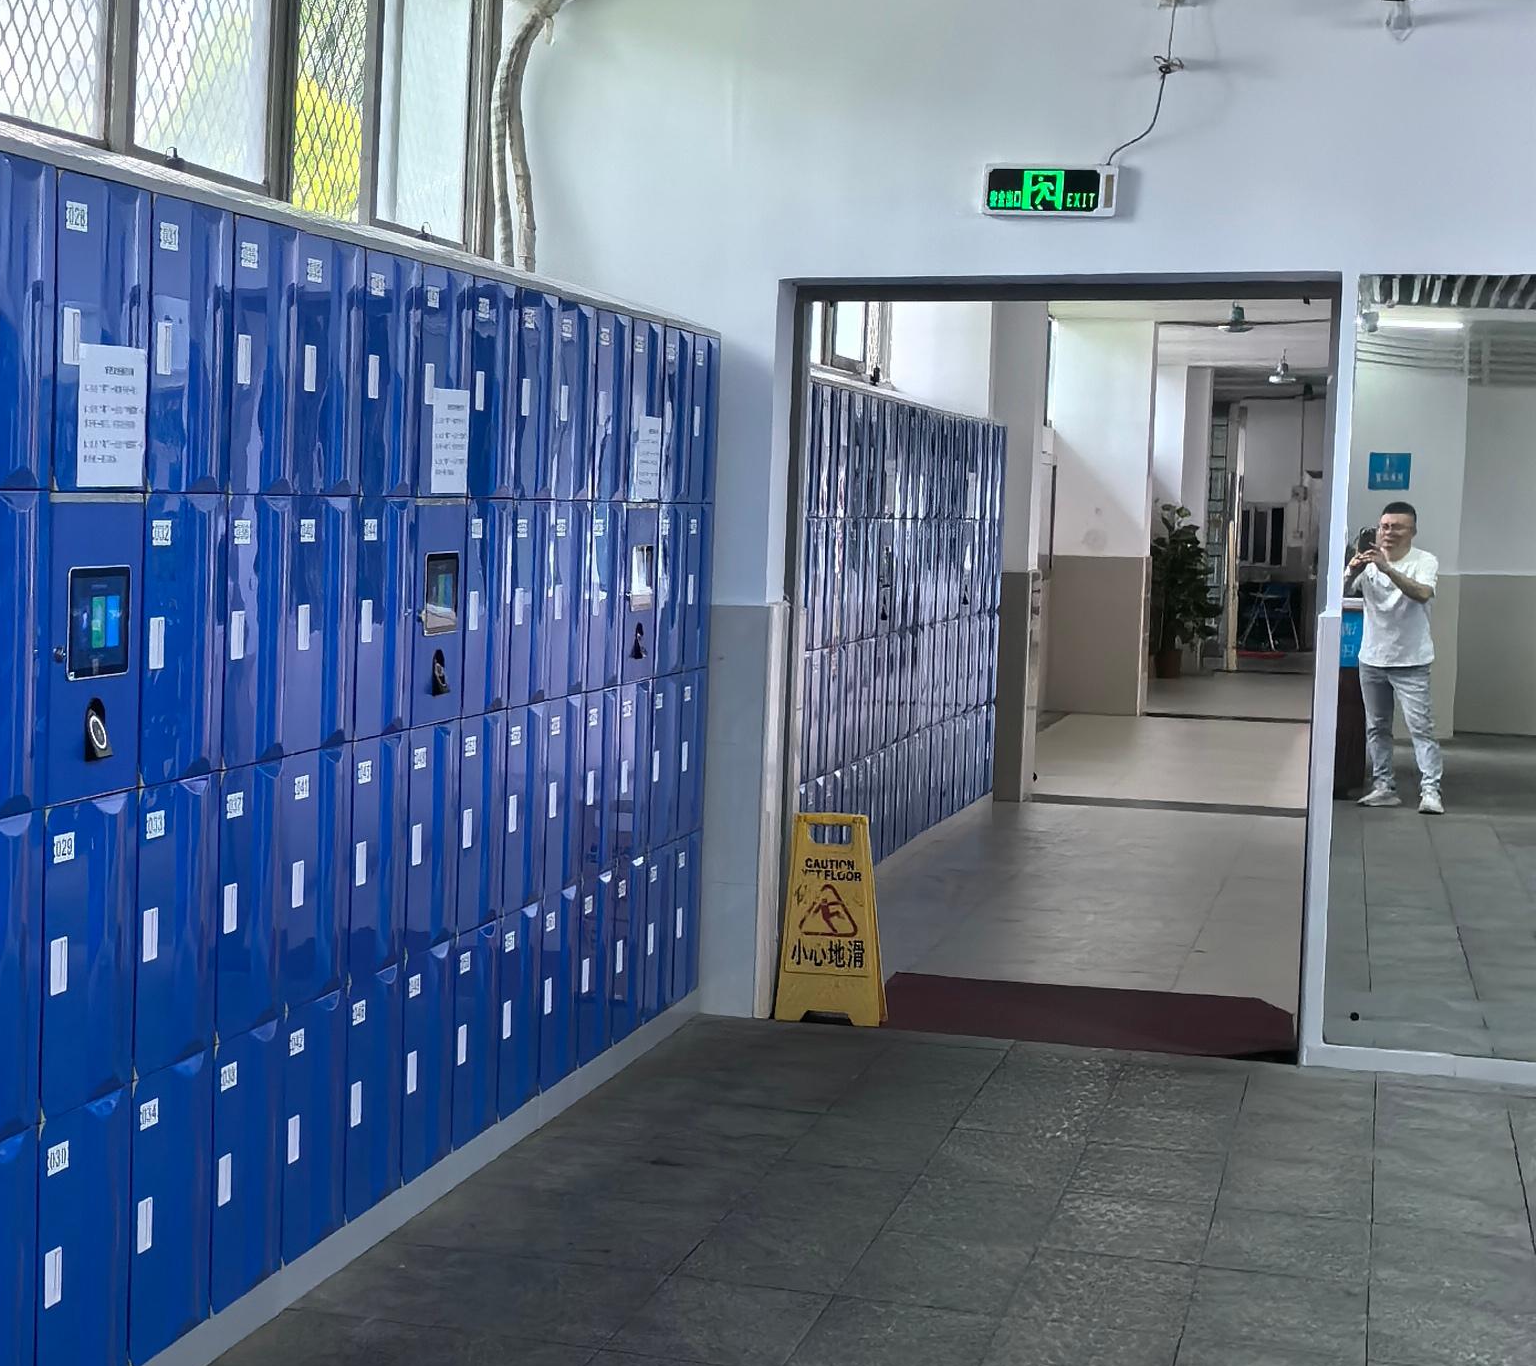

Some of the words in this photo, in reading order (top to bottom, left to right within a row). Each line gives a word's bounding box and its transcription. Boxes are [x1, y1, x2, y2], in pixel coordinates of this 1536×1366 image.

[1066, 193, 1095, 208] EXIT
[56, 838, 72, 857] 029
[805, 857, 855, 870] CAUTION
[824, 870, 861, 881] FLOOR
[791, 938, 864, 968] 小心地滑
